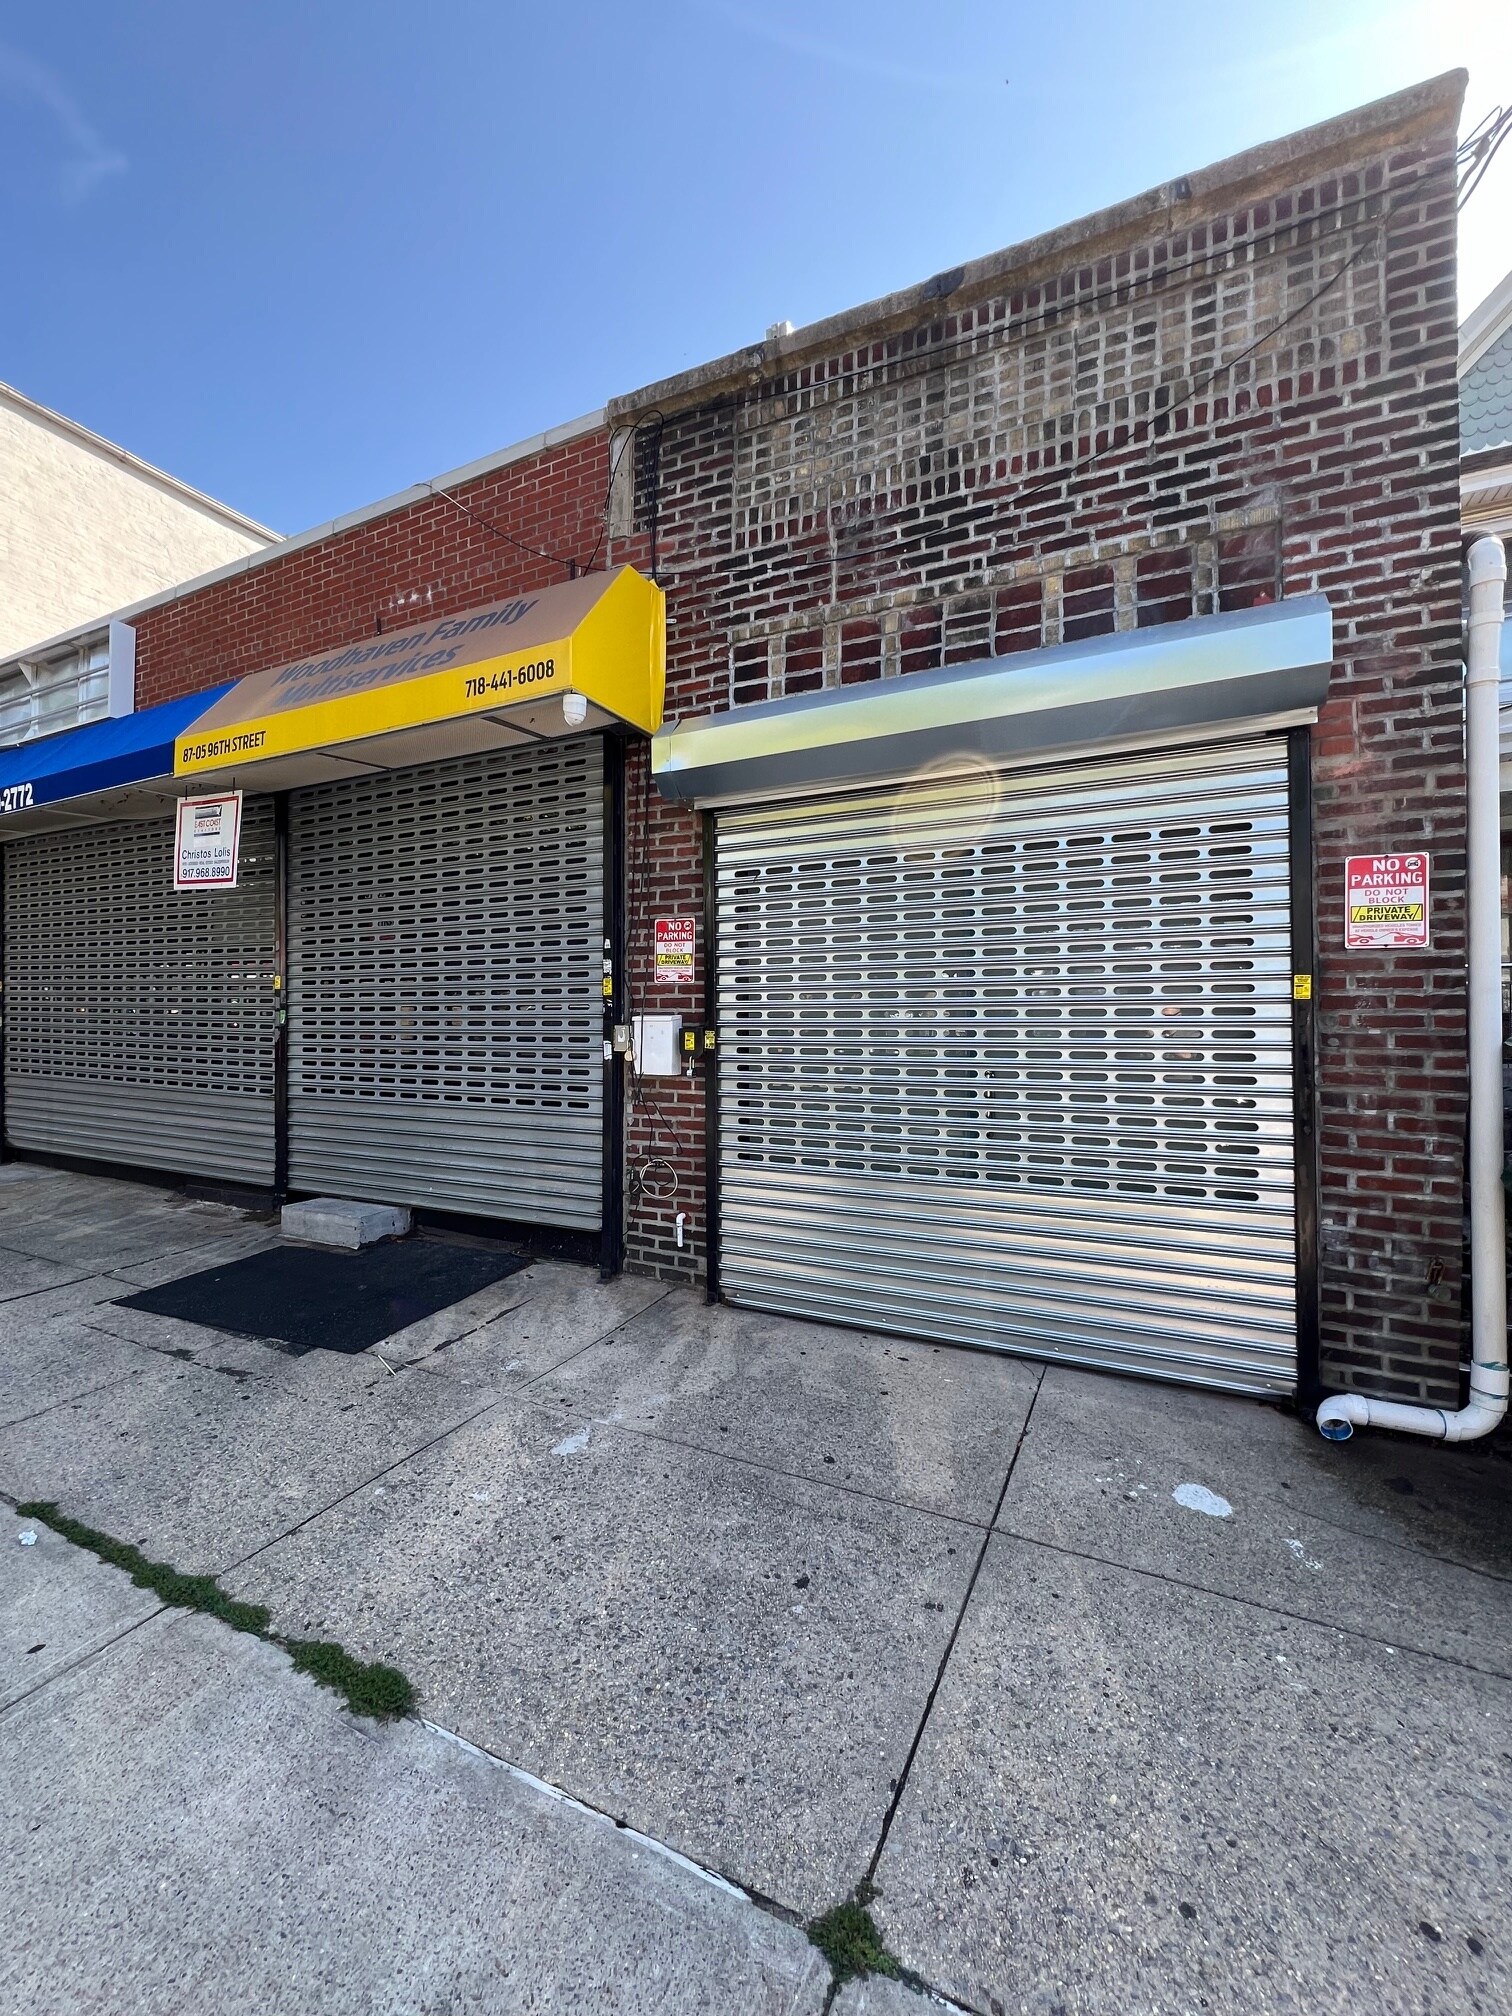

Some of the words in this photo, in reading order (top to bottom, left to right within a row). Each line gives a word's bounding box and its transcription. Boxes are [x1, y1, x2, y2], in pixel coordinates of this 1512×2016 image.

[272, 630, 426, 687] Woodhaven
[423, 598, 540, 645] Family
[273, 643, 461, 707] Multiservices
[464, 658, 556, 699] 718-441-6008
[182, 743, 207, 764] 87-05
[207, 736, 232, 759] 96TH
[232, 730, 267, 754] STREET
[0, 783, 33, 811] -2772
[195, 820, 206, 828] EAST
[206, 818, 221, 827] COAST
[182, 849, 211, 860] Christos
[214, 847, 230, 857] Lolis
[1372, 858, 1400, 872] NO
[1351, 872, 1422, 886] PARKING
[1364, 889, 1381, 897] DO
[1368, 896, 1405, 904] BLOCK
[1367, 906, 1411, 914] PRIVATE
[1359, 913, 1414, 921] DRIVEWAY
[668, 922, 682, 931] NO
[657, 931, 692, 940] PARKING
